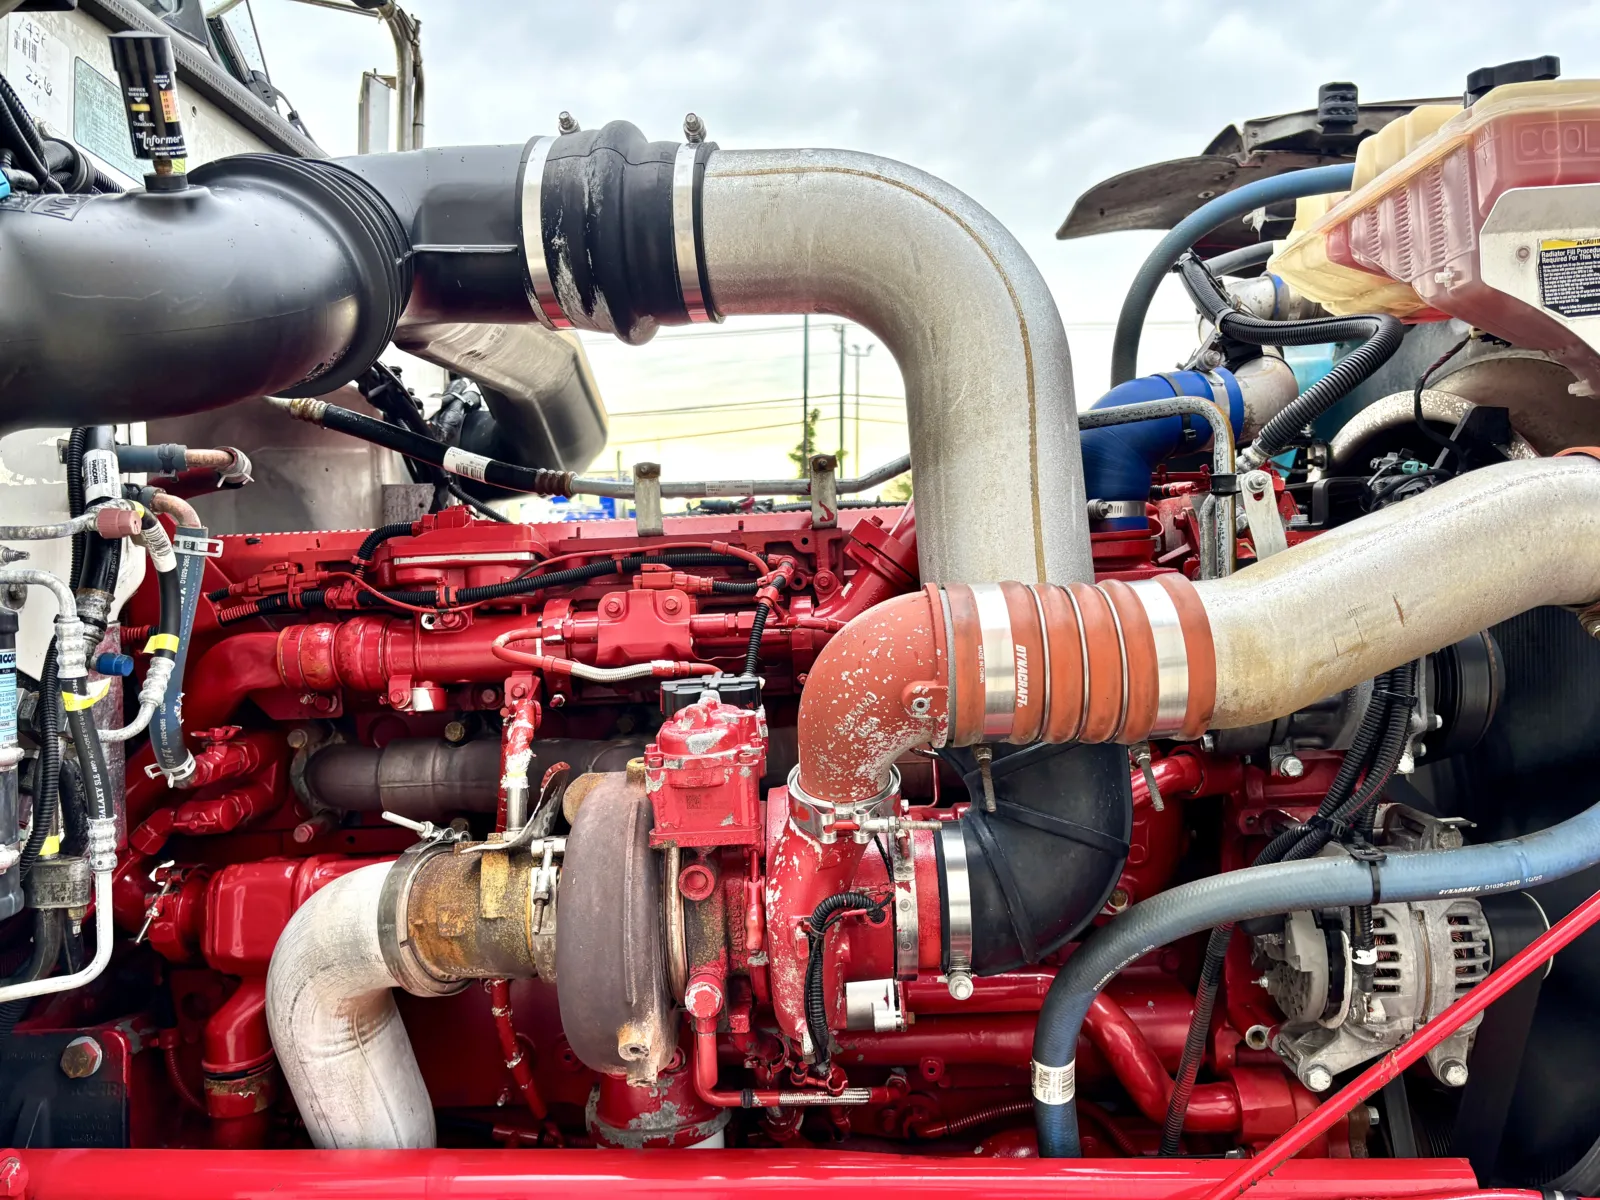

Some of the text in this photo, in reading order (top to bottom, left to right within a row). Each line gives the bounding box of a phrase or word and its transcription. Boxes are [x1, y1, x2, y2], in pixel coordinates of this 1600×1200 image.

[143, 131, 182, 150] Informer
[1541, 250, 1565, 258] Radiator
[91, 459, 99, 485] PACCAR
[1015, 643, 1029, 706] DYNACRAFT
[92, 774, 102, 786] SLE
